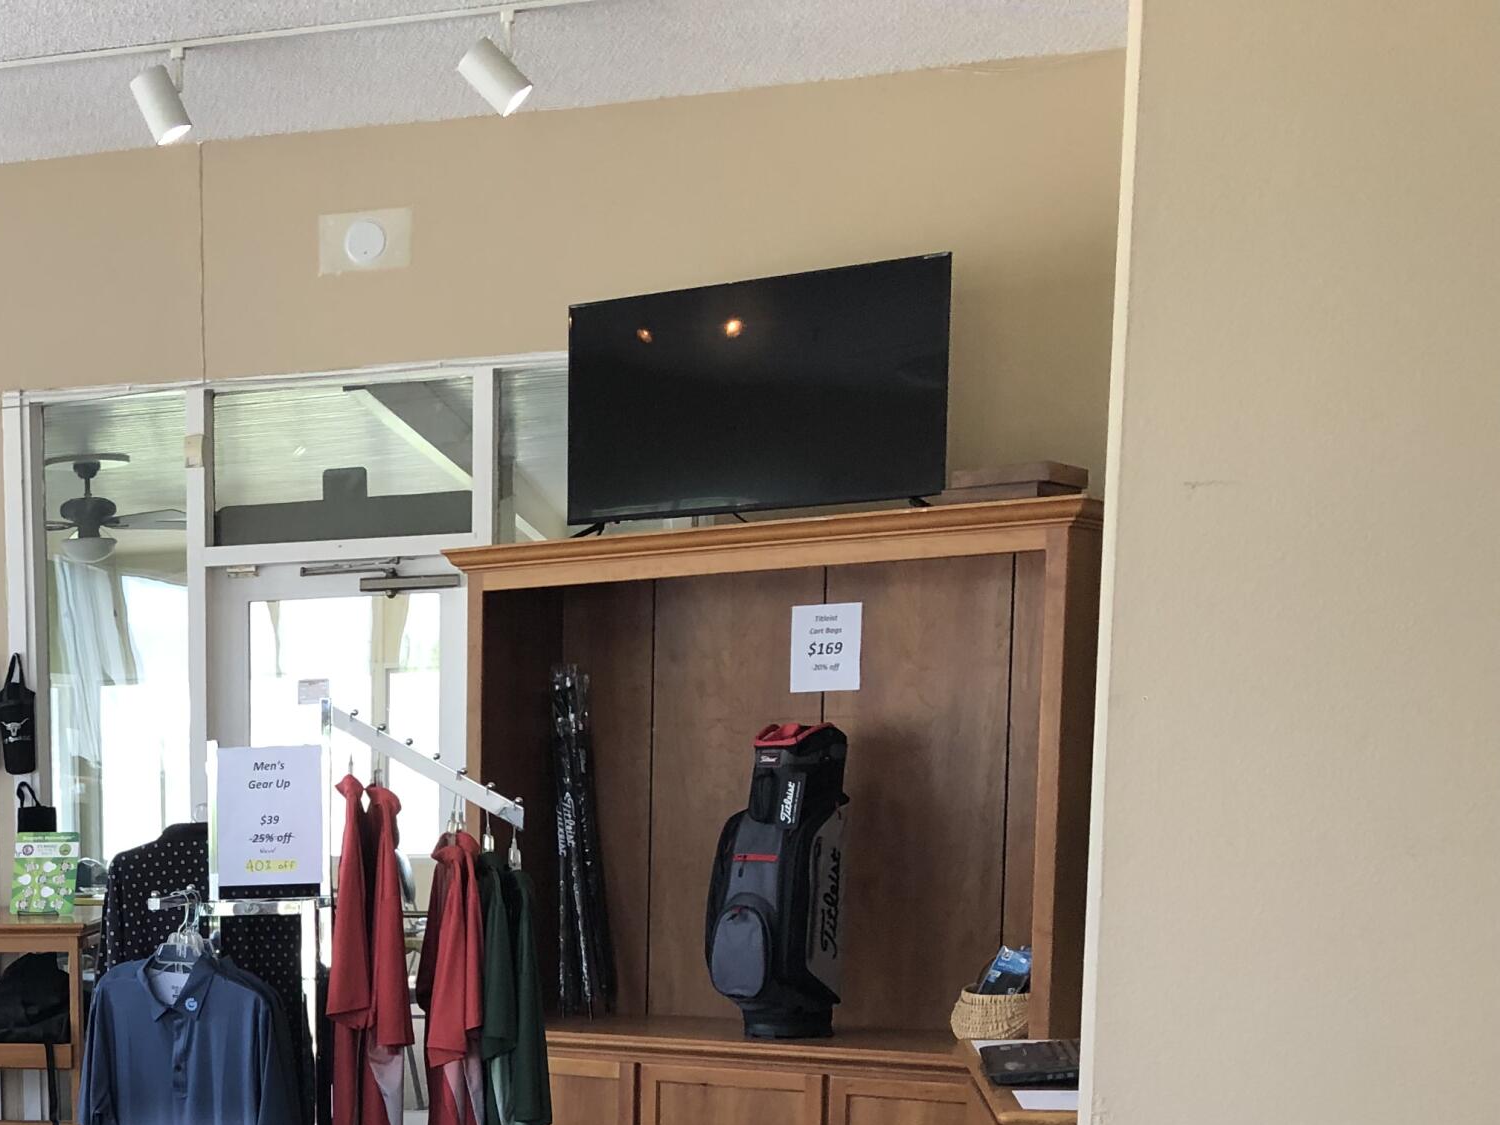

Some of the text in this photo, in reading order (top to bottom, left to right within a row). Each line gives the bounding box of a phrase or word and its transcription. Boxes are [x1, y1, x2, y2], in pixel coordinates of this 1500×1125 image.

[825, 627, 843, 635] Bags
[808, 641, 843, 658] $169
[829, 663, 840, 671] off
[253, 760, 285, 771] Men's
[248, 779, 291, 790] Gear Up
[780, 781, 795, 824] Titleist
[260, 815, 280, 826] $39
[276, 833, 292, 844] off
[821, 848, 841, 960] Titleist
